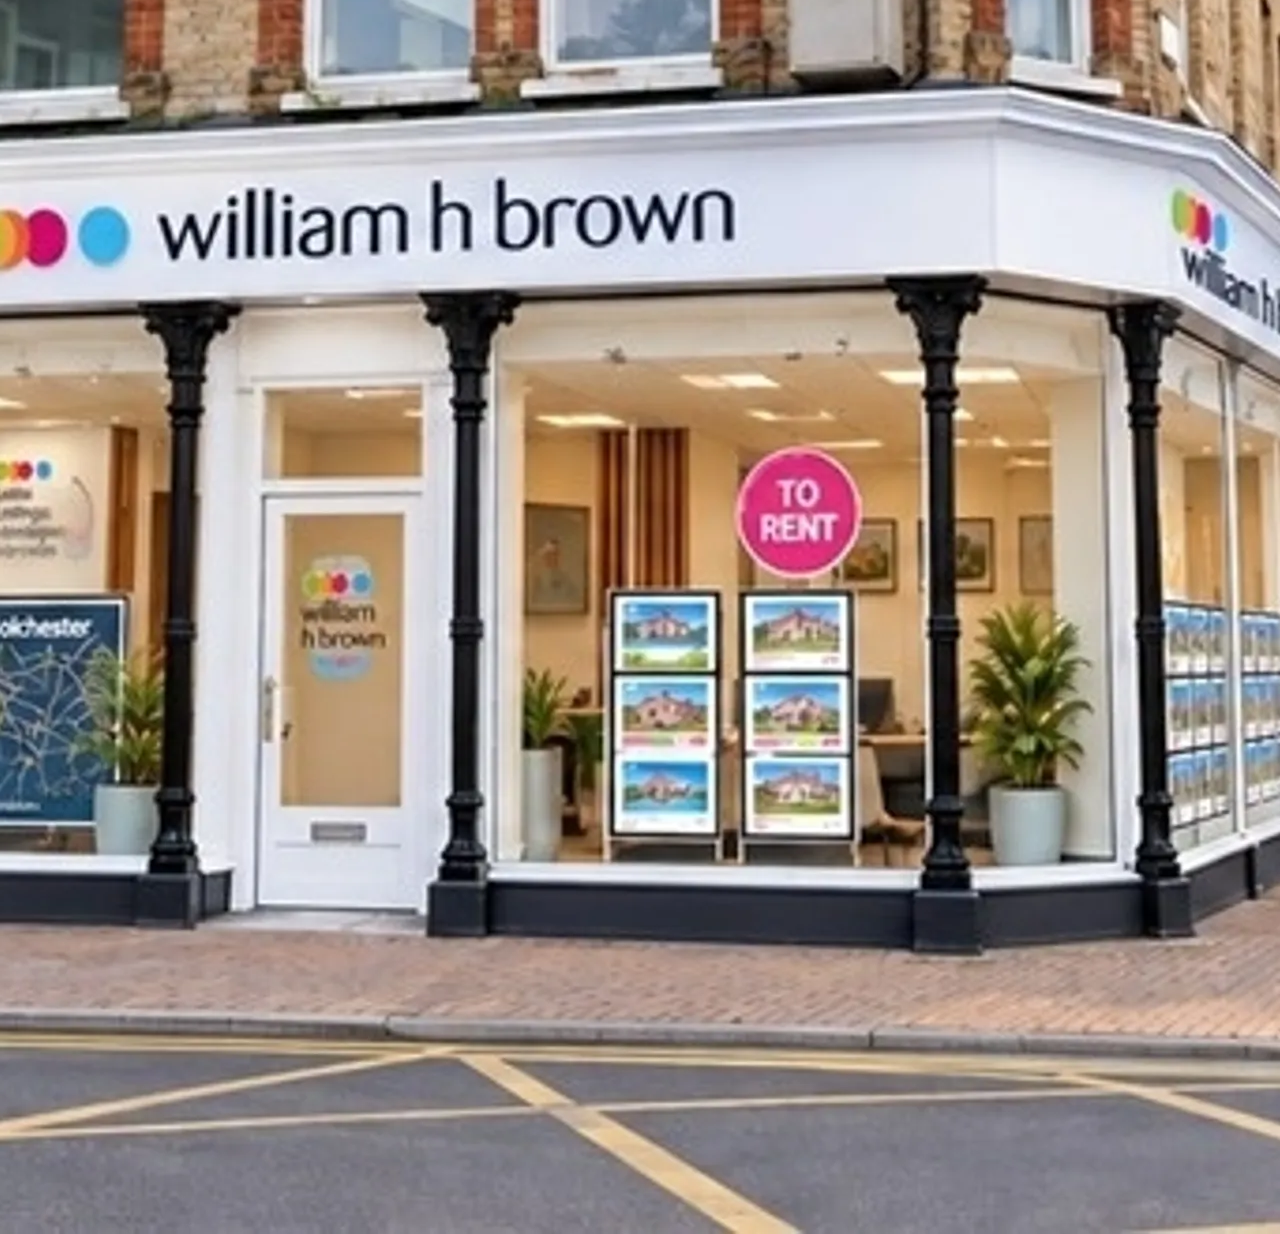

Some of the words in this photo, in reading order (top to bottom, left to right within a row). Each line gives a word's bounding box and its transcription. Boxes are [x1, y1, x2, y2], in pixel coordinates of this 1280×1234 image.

[157, 187, 408, 261] william
[431, 180, 472, 252] h
[495, 177, 735, 251] brown
[775, 478, 821, 509] TO
[760, 513, 839, 543] RENT
